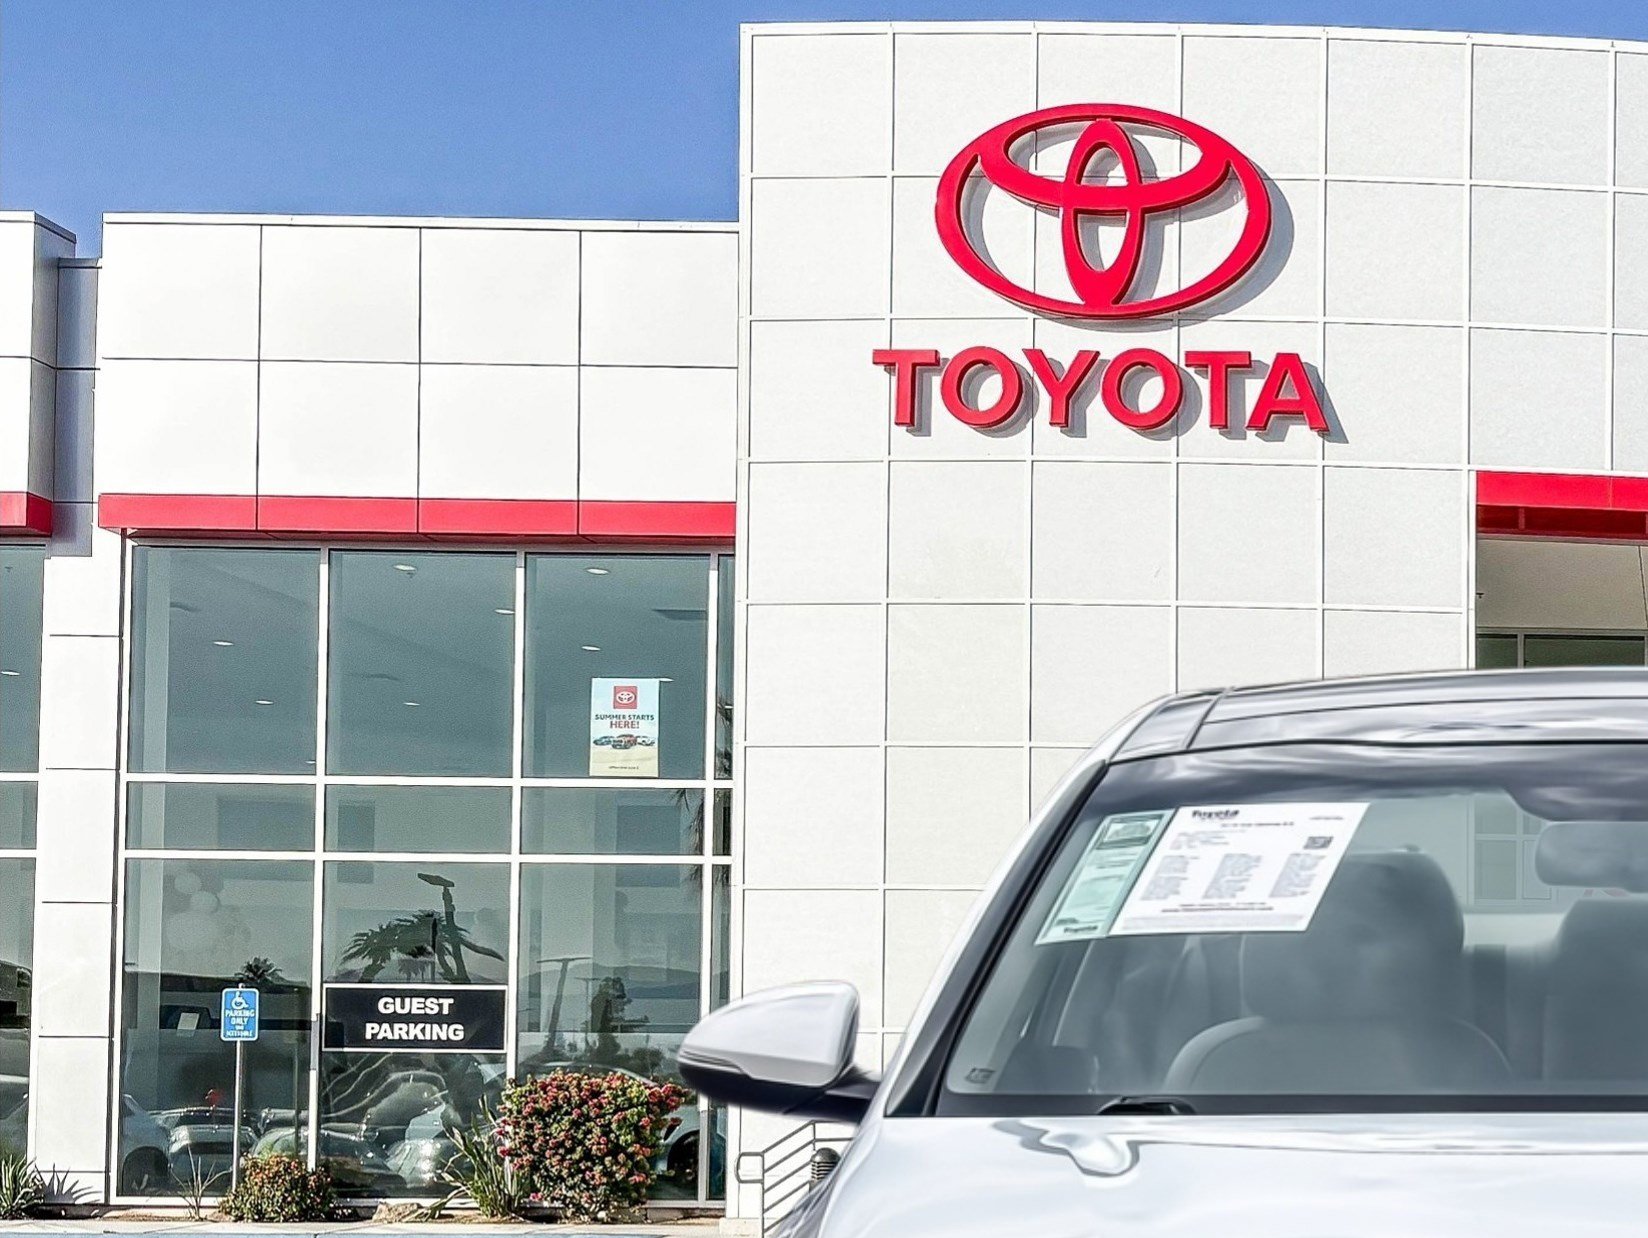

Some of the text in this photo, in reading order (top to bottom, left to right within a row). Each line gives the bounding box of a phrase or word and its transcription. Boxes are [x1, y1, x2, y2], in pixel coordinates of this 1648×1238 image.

[872, 345, 1330, 433] TOYOTA
[594, 713, 655, 721] SUMMER STARTS
[609, 720, 640, 729] HERE!
[377, 997, 455, 1016] GUEST
[364, 1022, 465, 1041] PARKING
